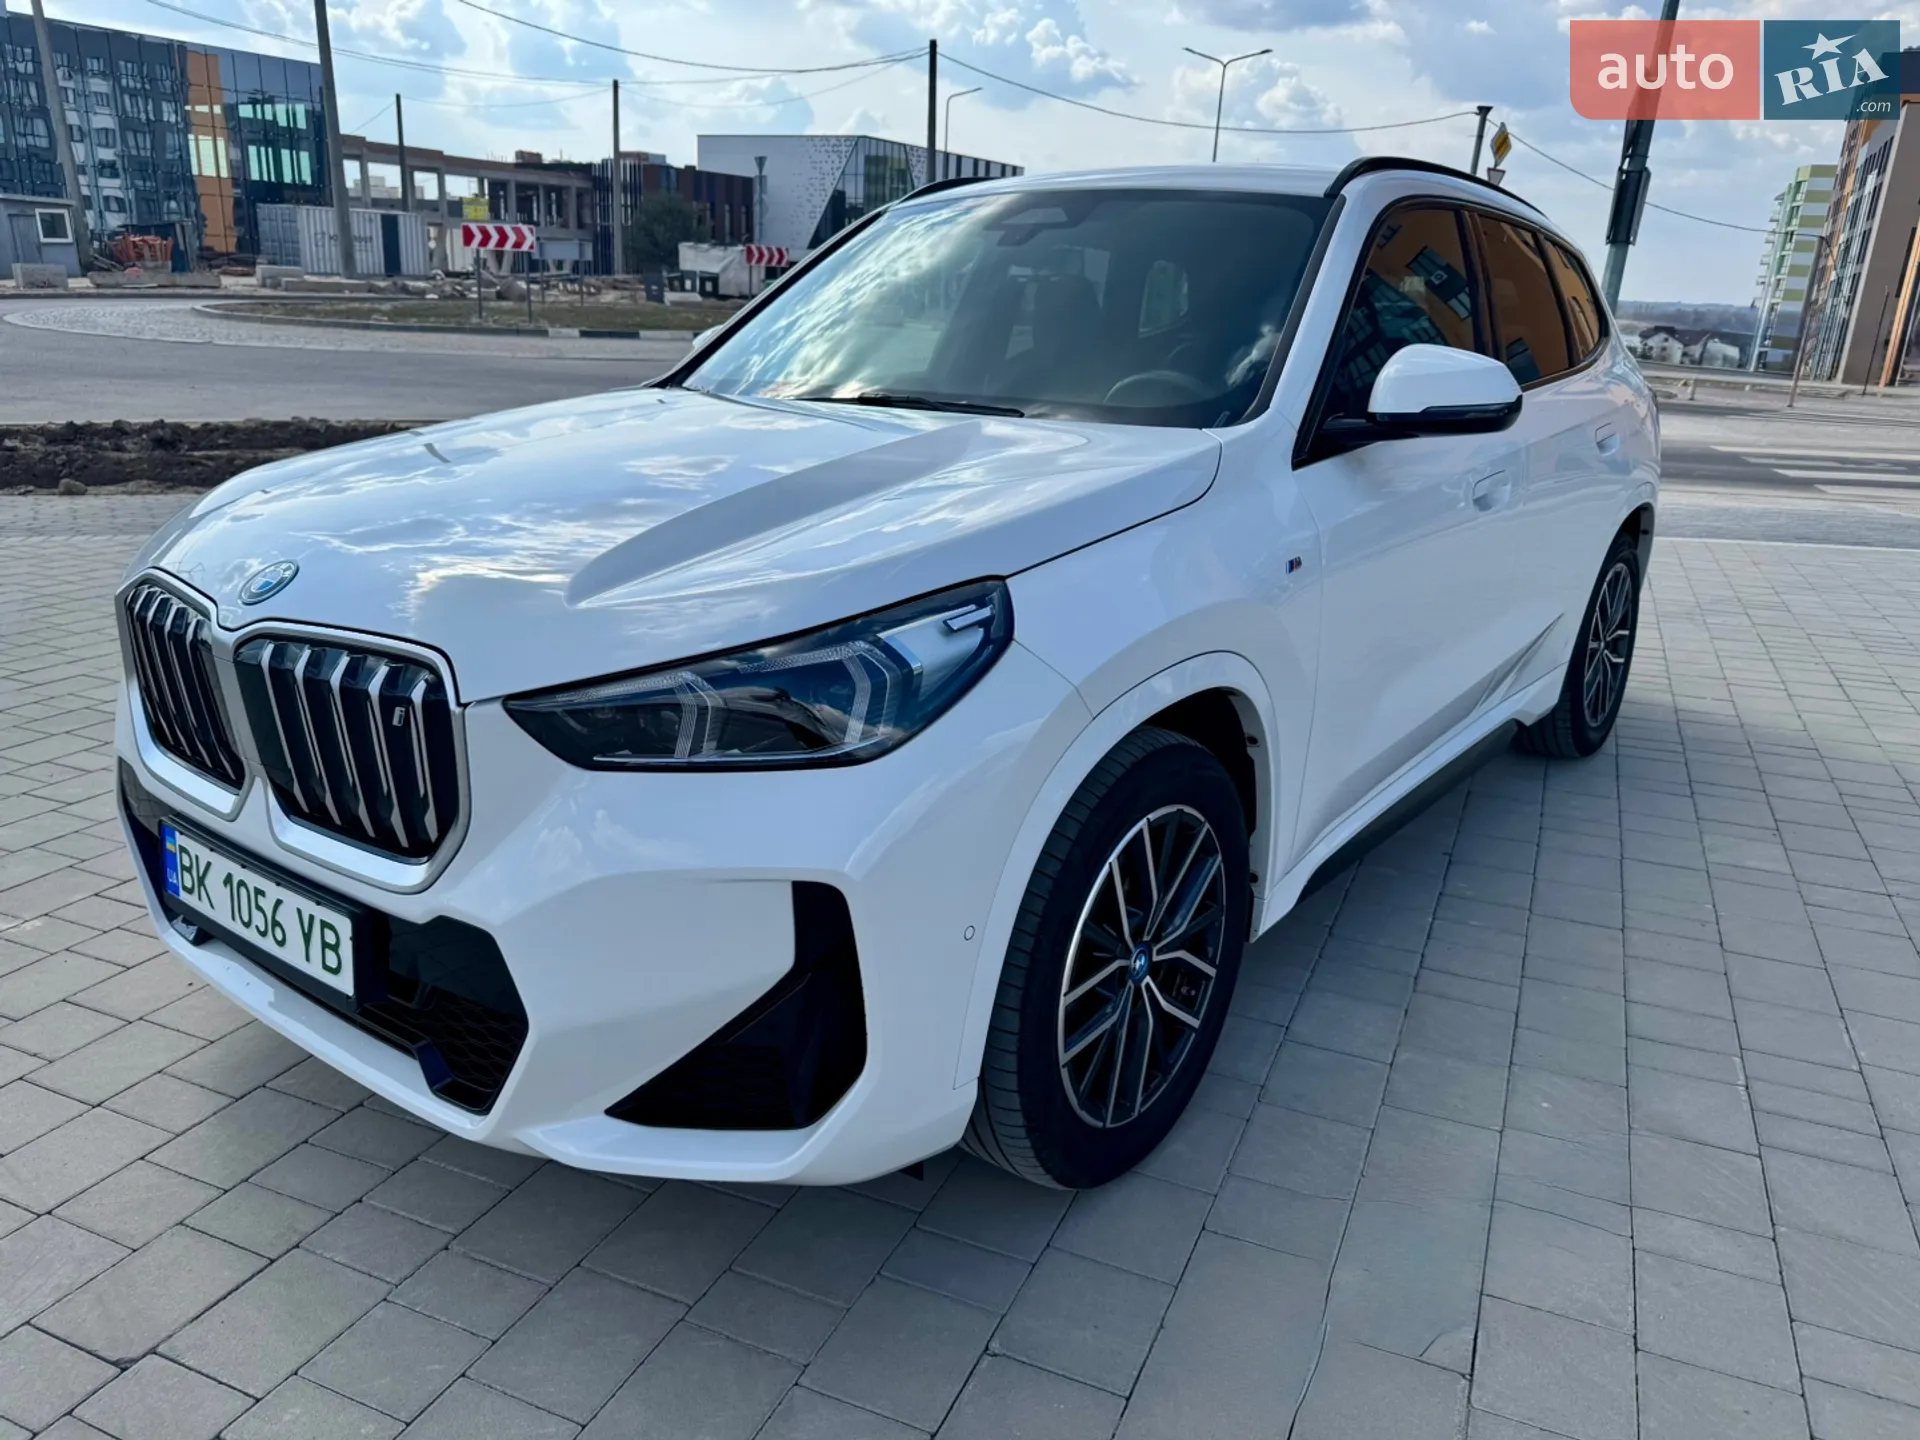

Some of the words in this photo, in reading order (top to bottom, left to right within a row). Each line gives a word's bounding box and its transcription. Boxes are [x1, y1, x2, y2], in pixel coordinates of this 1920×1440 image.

[178, 844, 215, 911] BK
[222, 872, 287, 948] 1056
[296, 907, 343, 976] YB
